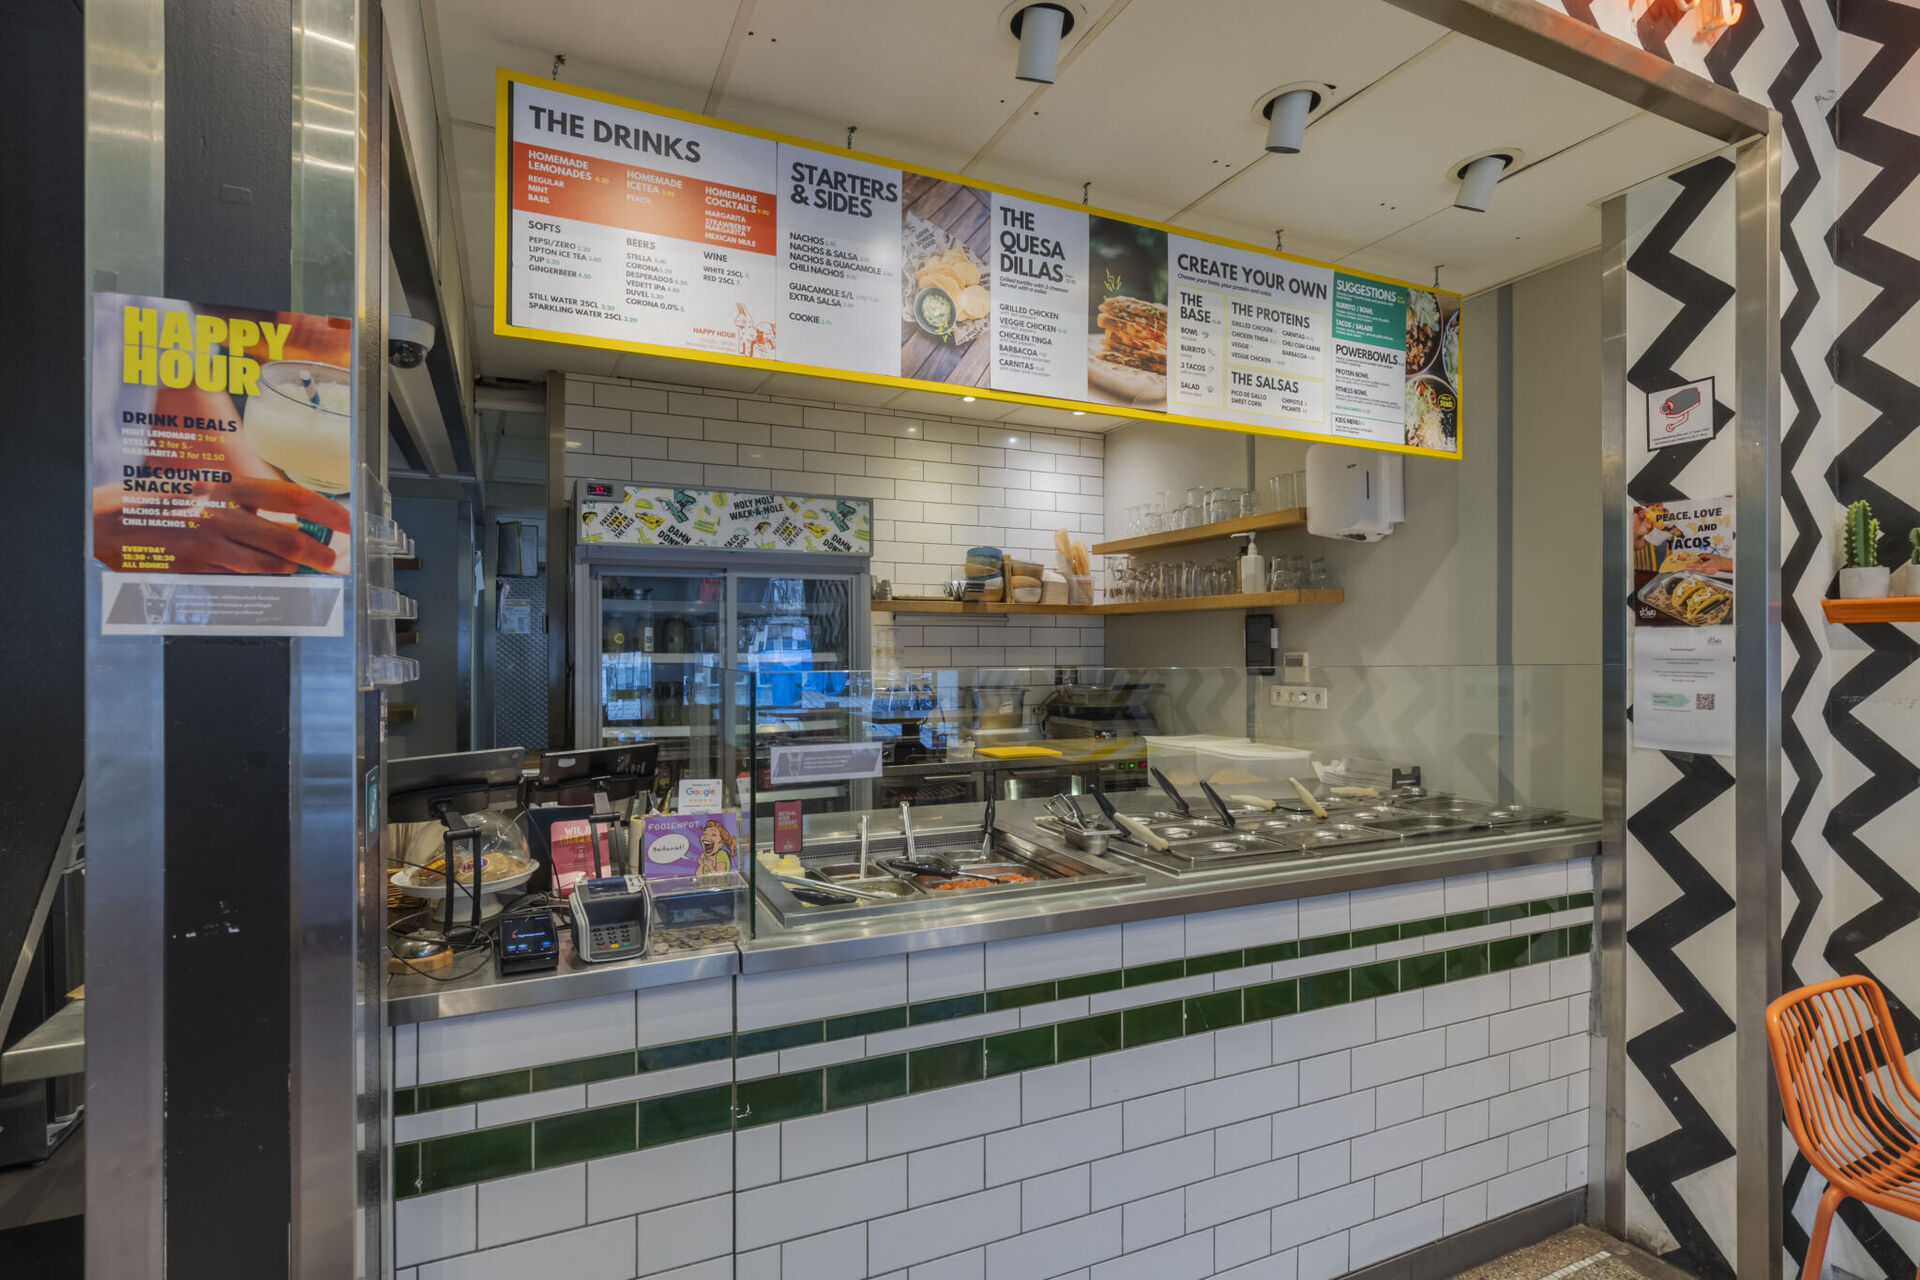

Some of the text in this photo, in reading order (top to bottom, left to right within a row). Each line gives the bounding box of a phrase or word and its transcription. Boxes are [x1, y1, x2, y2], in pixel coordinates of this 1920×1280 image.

[529, 105, 701, 163] THE DRINKS
[528, 150, 588, 169] HOMEMADE
[528, 160, 592, 180] LEMONADES
[528, 175, 564, 187] REGULAR
[626, 170, 683, 189] HOMEMADE
[791, 162, 898, 203] STARTERS
[528, 184, 548, 193] MINT
[705, 186, 758, 203] HOMEMADE
[528, 193, 550, 204] BASIL
[705, 196, 756, 214] COCKTAILS
[791, 184, 873, 218] & SIDES
[705, 210, 746, 223] MARGARITA
[1000, 206, 1034, 231] THE
[528, 221, 561, 233] SOFTS
[705, 218, 751, 232] STRAWBERRY
[705, 225, 746, 237] MARGARITA
[529, 236, 576, 250] PEPSI/ZERO
[626, 237, 656, 250] BEERS
[705, 233, 756, 248] MEXICAN MULE
[789, 232, 824, 245] NACHOS
[1000, 230, 1065, 260] QUESA
[529, 245, 587, 261] LIPTON ICE TEA
[626, 252, 652, 263] STELLA
[703, 251, 728, 263] WINE
[789, 242, 858, 261] NACHOS & SALSA
[626, 261, 659, 273] CORONA
[789, 252, 881, 275] NACHOS & GUACAMOLE
[789, 262, 844, 278] CHILI NACHOS
[1000, 253, 1063, 283] DILLAS
[529, 264, 577, 277] GINGERBEER
[626, 270, 673, 284] DESPERADOS
[703, 265, 744, 278] WHITE 25CL
[1177, 253, 1238, 281] CREATE
[1242, 267, 1285, 291] YOUR
[1289, 278, 1327, 300] OWN
[626, 279, 666, 292] VEDETT IPA
[703, 274, 736, 285] RED 25CL
[626, 288, 650, 298] DUVEL
[789, 282, 839, 297] GUACAMOLE
[1336, 280, 1396, 302] SUGGESTIONS
[529, 292, 598, 309] STILL WATER 25CL
[626, 297, 659, 309] CORONA
[789, 292, 841, 308] EXTRA SALSA
[1180, 292, 1202, 308] THE
[529, 301, 623, 321] SPARKLING WATER 25CL
[1000, 304, 1058, 320] GRILLED CHICKEN
[1180, 307, 1211, 324] BASE
[1231, 302, 1310, 329] THE PROTEINS
[789, 312, 820, 324] COOKIE
[1000, 317, 1056, 333] VEGGIE CHICKEN
[1180, 326, 1198, 336] BOWL
[1251, 323, 1273, 334] CHICKEN
[124, 305, 292, 361] HAPPY
[693, 327, 736, 338] HAPPY HOUR
[999, 331, 1052, 346] CHICKEN TINGA
[1231, 331, 1268, 343] CHICKEN TINGA
[999, 344, 1037, 356] BARBACOA
[1180, 344, 1206, 354] BURRITO
[1231, 341, 1249, 350] VEGGIE
[1250, 354, 1271, 364] CHICKEN
[1336, 344, 1398, 365] POWERBOWLS
[123, 344, 261, 397] HOUR
[999, 359, 1033, 370] CARNITAS
[1186, 363, 1206, 372] TACOS
[1336, 368, 1369, 379] PROTEIN BOWL
[1180, 381, 1200, 391] SALAD
[1231, 371, 1299, 393] THE SALSAS
[1251, 392, 1267, 400] GALLO
[1336, 386, 1353, 394] FITNESS
[1231, 398, 1262, 408] SWEET CORN
[1281, 405, 1301, 413] PICANTE
[122, 411, 237, 432] DRINK DEALS
[122, 427, 196, 440] MINT LEMONADE
[122, 438, 179, 448] STELLA 2 for
[122, 448, 177, 459] MARGARITA
[180, 451, 185, 459] 2
[123, 465, 232, 483] DISCOUNTED
[123, 479, 193, 495] SNACKS
[122, 496, 160, 506] NACHOS
[171, 498, 227, 509] GUACAMOLE
[733, 494, 775, 510] HOLY MOLY
[122, 507, 160, 516] NACHOS
[171, 510, 200, 518] SALSA
[1656, 507, 1722, 522] PEACE, LOVE
[122, 518, 186, 528] CHILI NACHOS
[1698, 524, 1717, 532] AND
[668, 525, 691, 545] DAMN
[122, 545, 165, 554] EVERYDAY
[832, 534, 853, 552] DAMN
[1667, 536, 1711, 550] TACOS
[686, 788, 715, 798] Google
[648, 821, 699, 830] FOOIENPOT
